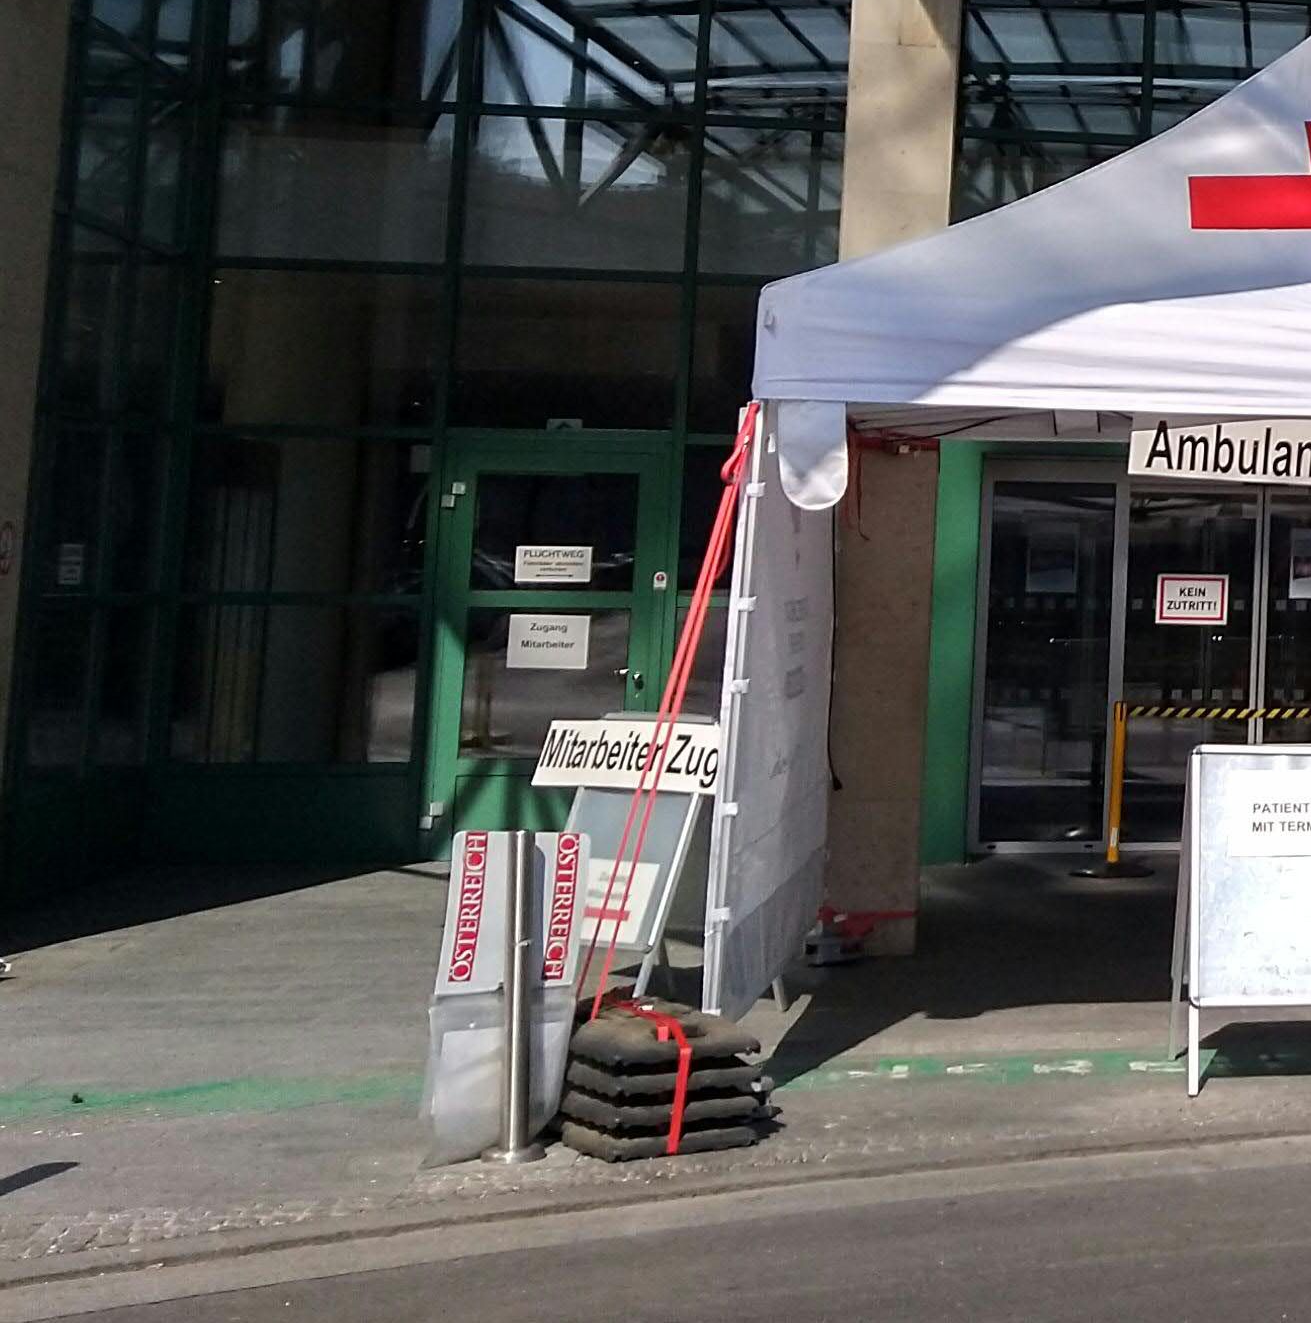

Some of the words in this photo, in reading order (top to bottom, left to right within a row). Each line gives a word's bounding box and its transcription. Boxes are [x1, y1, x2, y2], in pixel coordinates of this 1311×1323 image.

[523, 549, 585, 558] FLUCHTWEG
[1179, 587, 1206, 597] KEIN
[1167, 600, 1217, 611] ZUTRITT!
[530, 622, 568, 633] Zugang
[520, 639, 575, 649] Mitarbeiter
[540, 728, 666, 772] Mitarbeiter
[1252, 821, 1275, 833] MIT
[448, 833, 488, 981] ÖSTERREICH
[544, 833, 581, 979] ÖSTERREICH
